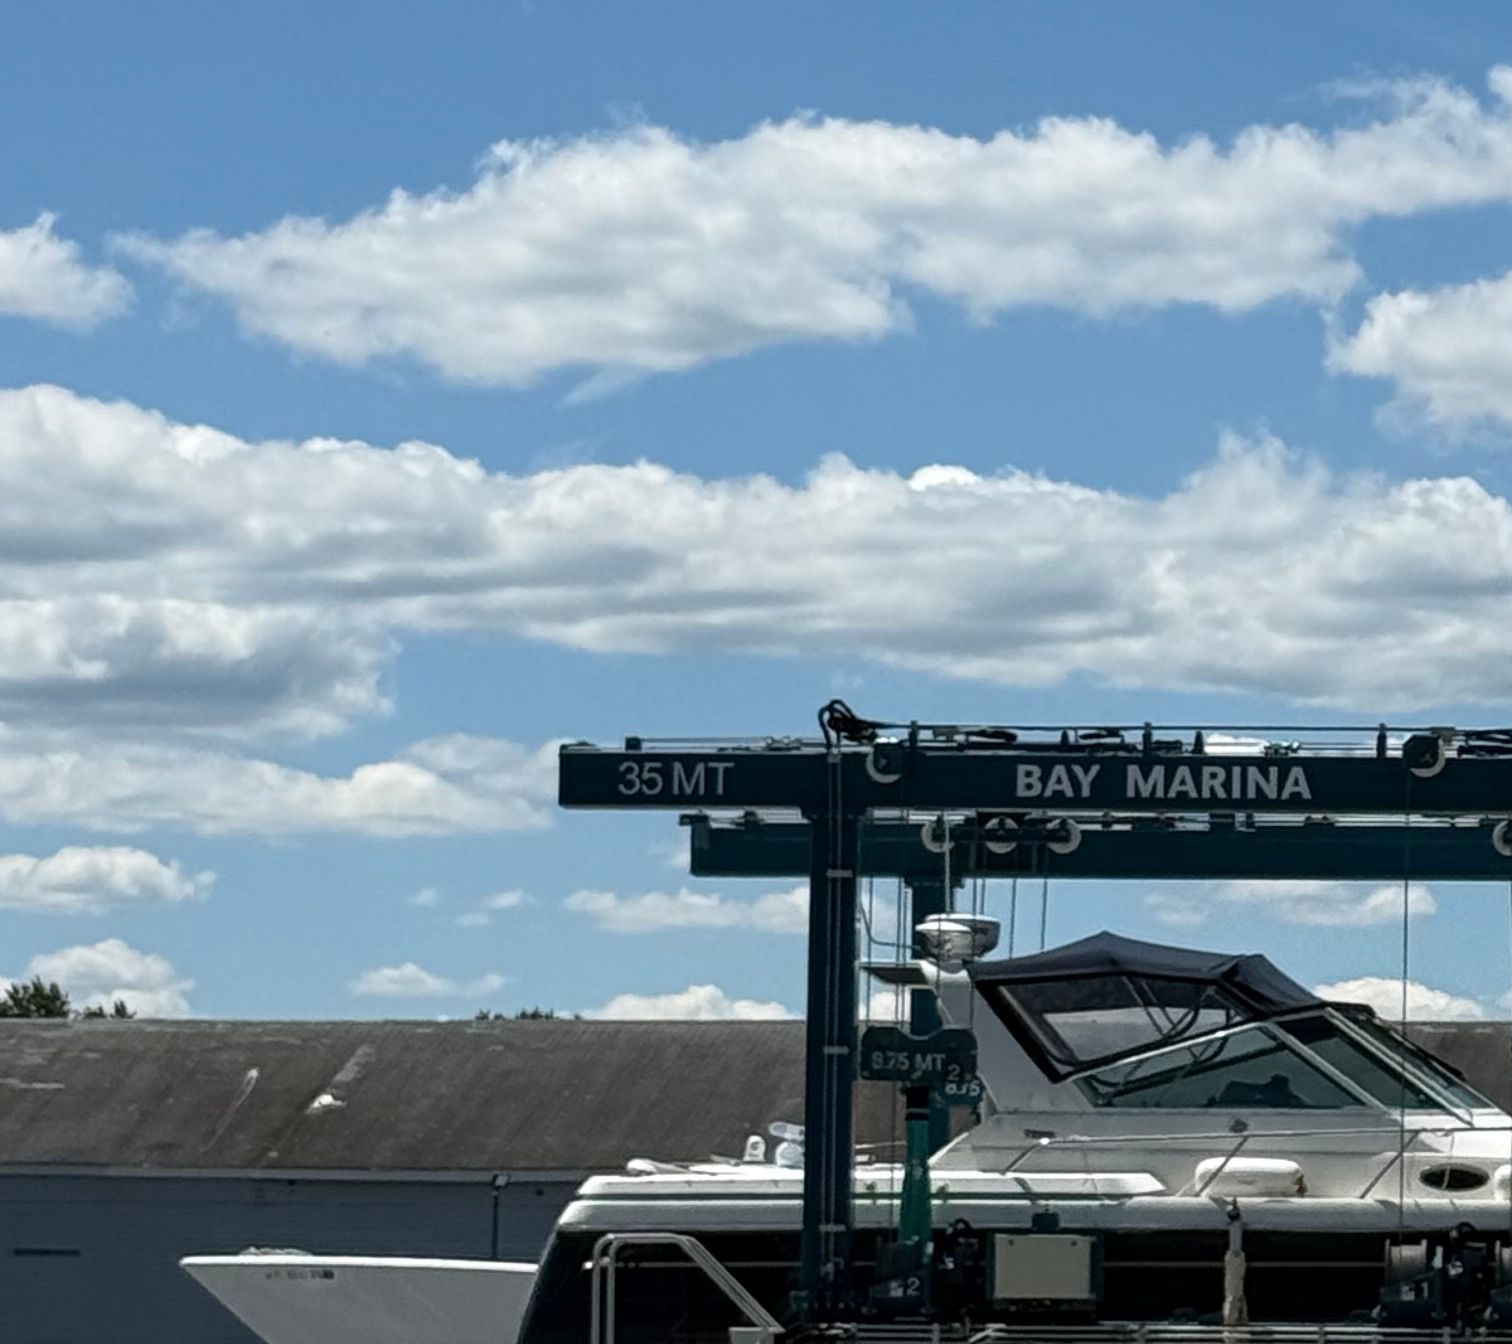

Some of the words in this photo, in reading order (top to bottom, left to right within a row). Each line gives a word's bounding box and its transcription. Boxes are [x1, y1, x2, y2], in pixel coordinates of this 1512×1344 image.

[618, 761, 663, 795] 35
[672, 761, 735, 795] MT
[1015, 763, 1100, 798] BAY
[1125, 764, 1312, 800] MARINA
[907, 1276, 920, 1296] 2
[1420, 1281, 1429, 1299] 1
